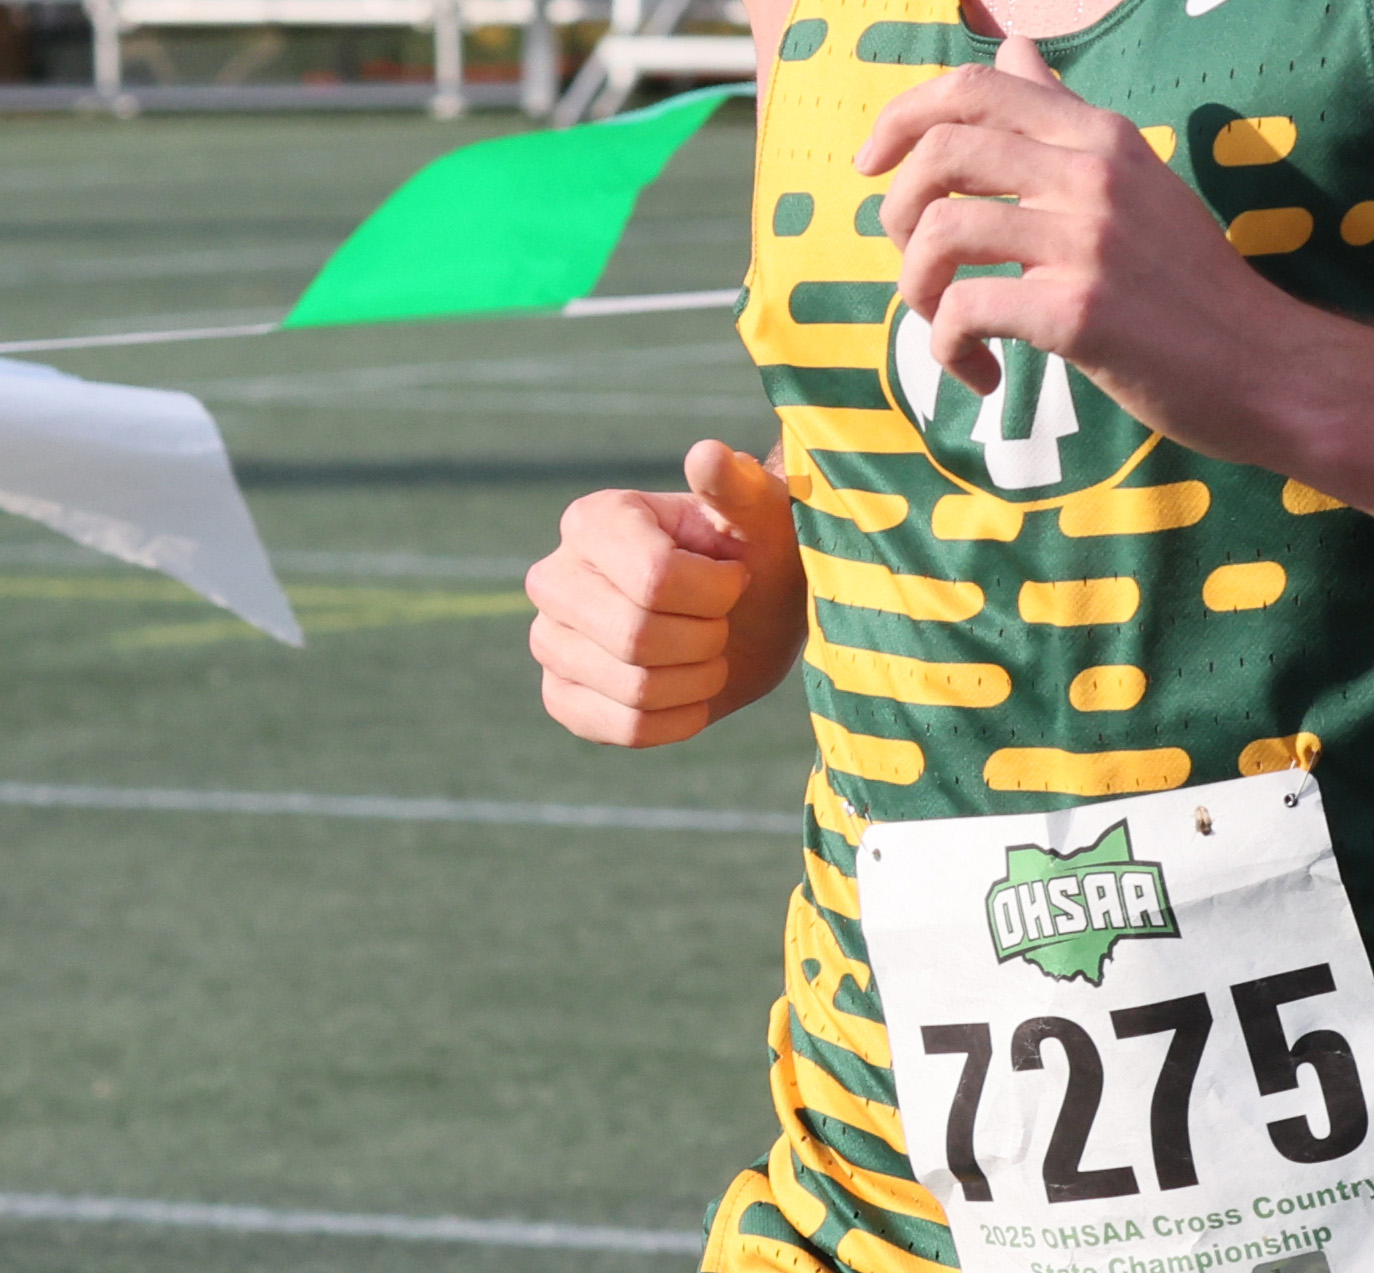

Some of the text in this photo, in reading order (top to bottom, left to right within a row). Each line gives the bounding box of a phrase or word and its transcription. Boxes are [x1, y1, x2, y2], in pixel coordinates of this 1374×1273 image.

[992, 871, 1168, 951] OHSAA
[920, 963, 1369, 1204] 7275
[980, 1224, 1036, 1249] 2025
[1041, 1219, 1145, 1249] OHSAA
[1152, 1208, 1243, 1237] Cross
[1108, 1226, 1333, 1273] Championship
